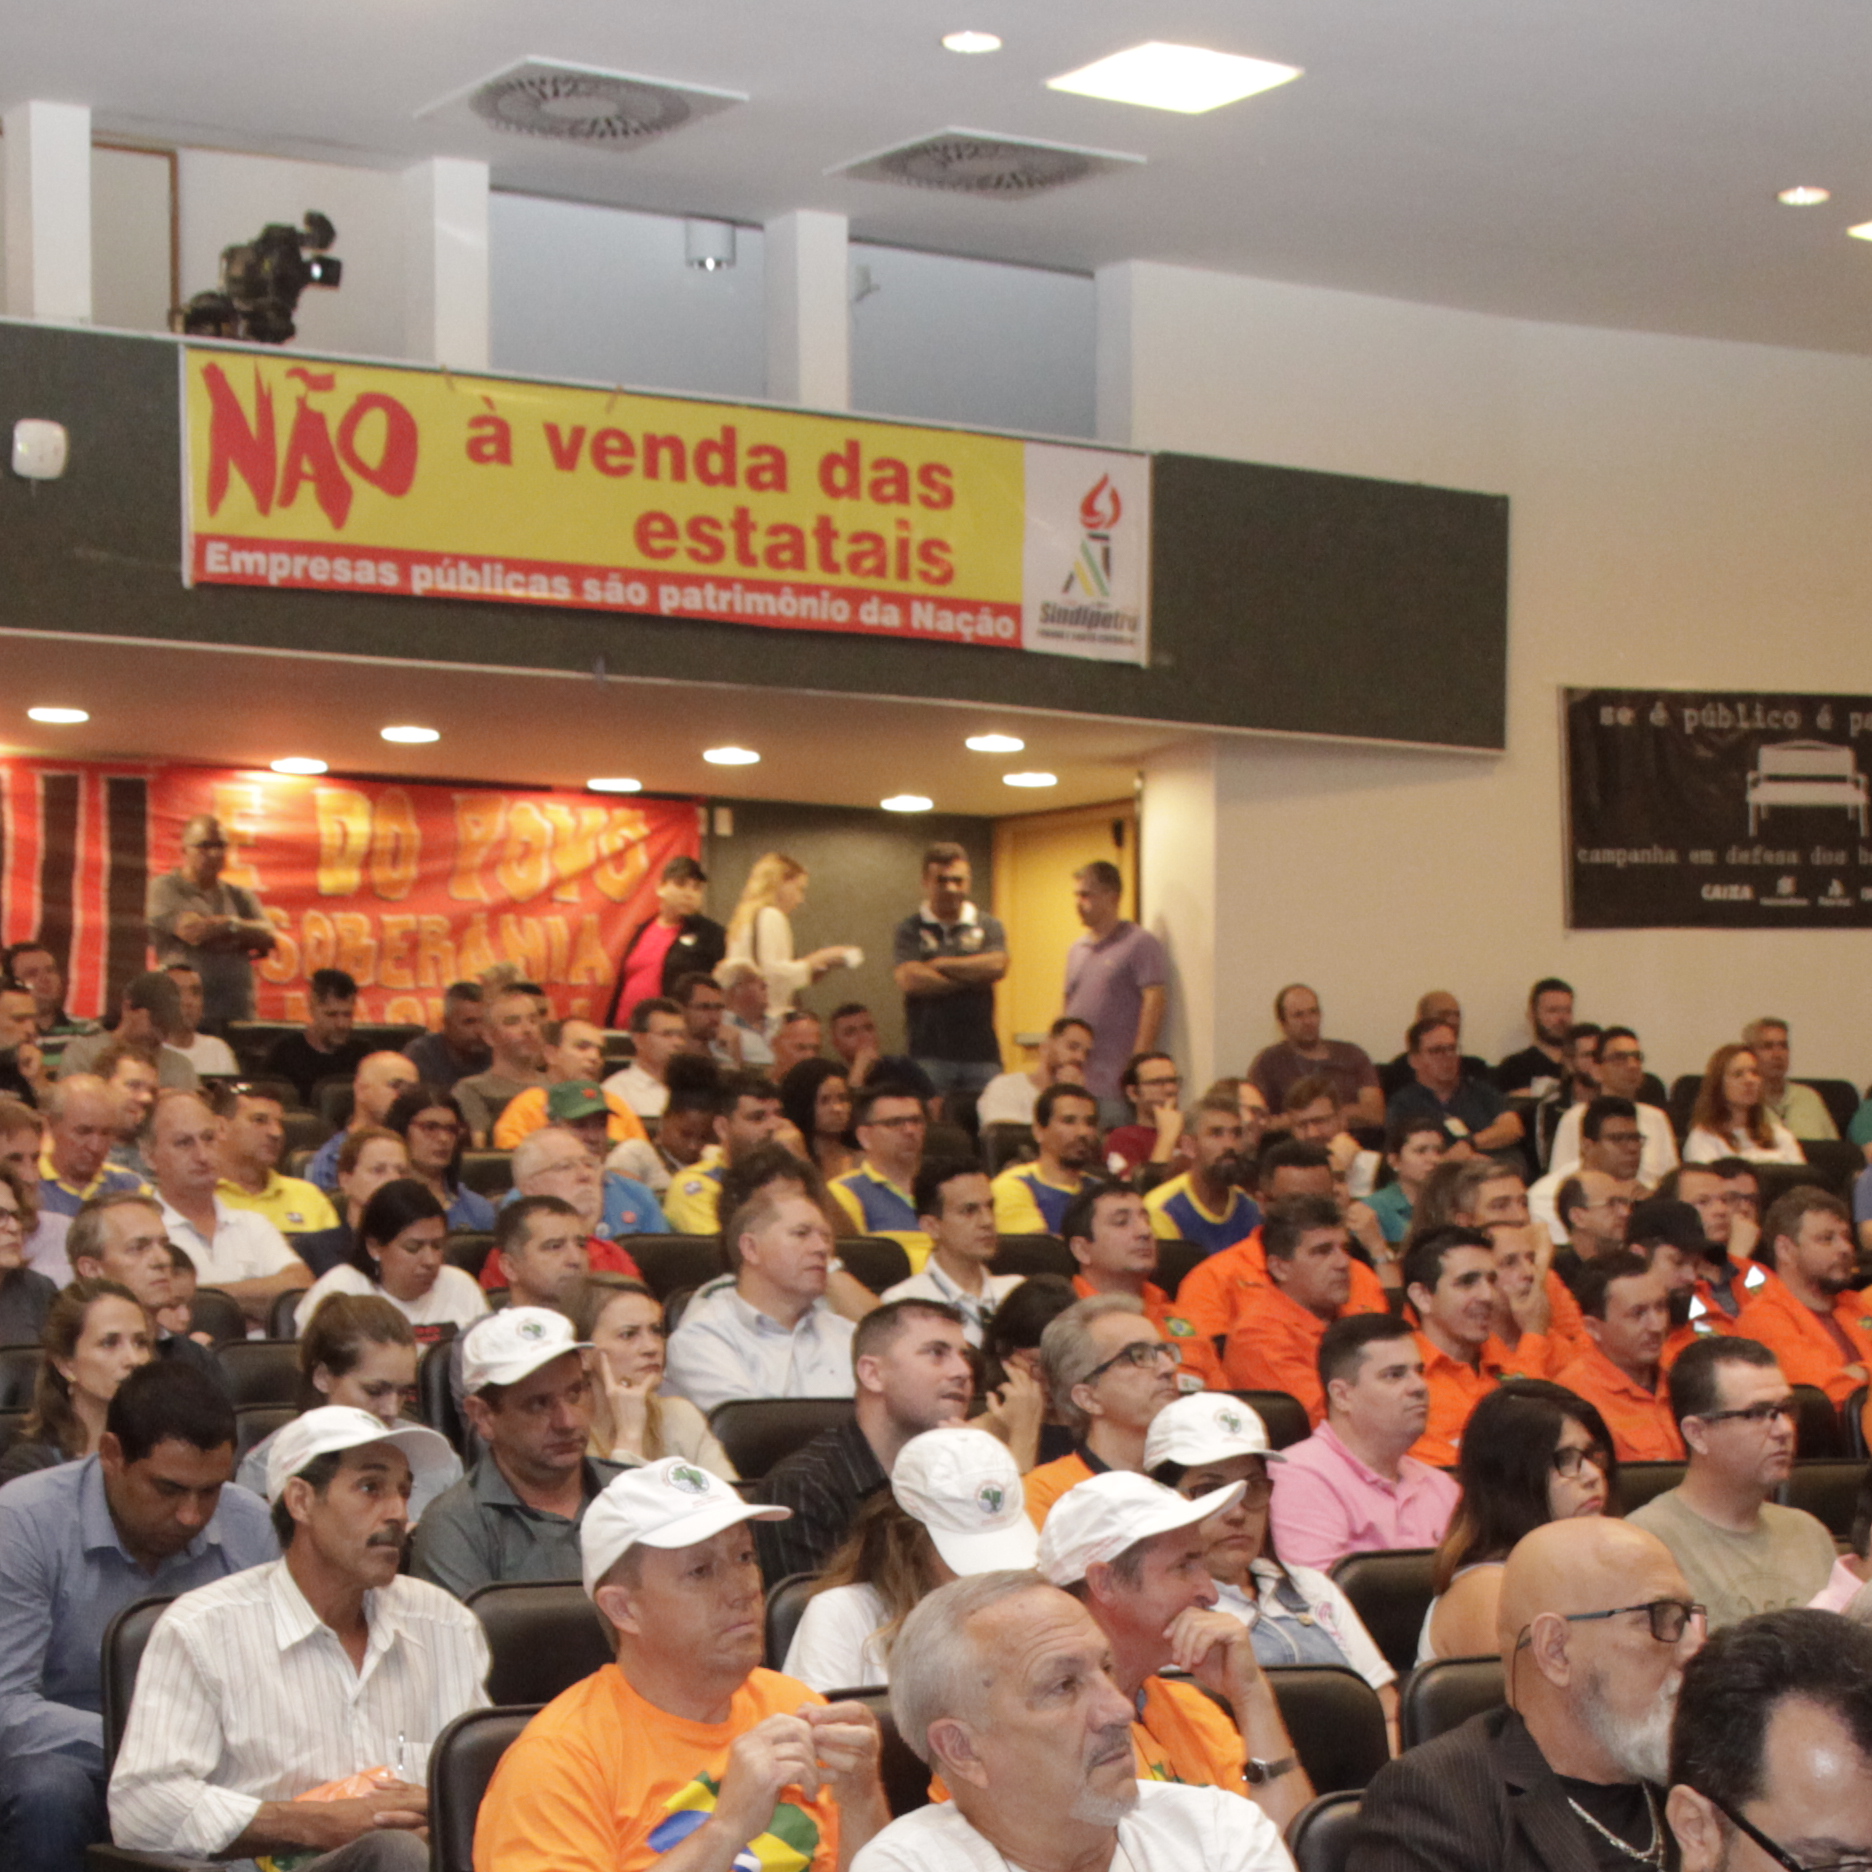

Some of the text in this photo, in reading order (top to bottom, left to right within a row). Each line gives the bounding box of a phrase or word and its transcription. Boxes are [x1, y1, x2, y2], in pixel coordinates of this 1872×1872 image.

[201, 361, 419, 530] NÃO
[465, 398, 955, 510] à venda das
[204, 540, 399, 586] Empresas
[410, 557, 571, 599] públicas
[582, 572, 647, 607] são
[658, 581, 850, 624] patrimônio
[859, 596, 902, 628] da
[911, 600, 1016, 642] Nação
[632, 510, 955, 587] estatais
[1599, 705, 1633, 727] se
[1683, 701, 1802, 735] público
[314, 786, 422, 900] DO
[446, 793, 651, 902] POVO
[1577, 845, 1678, 868] campanha
